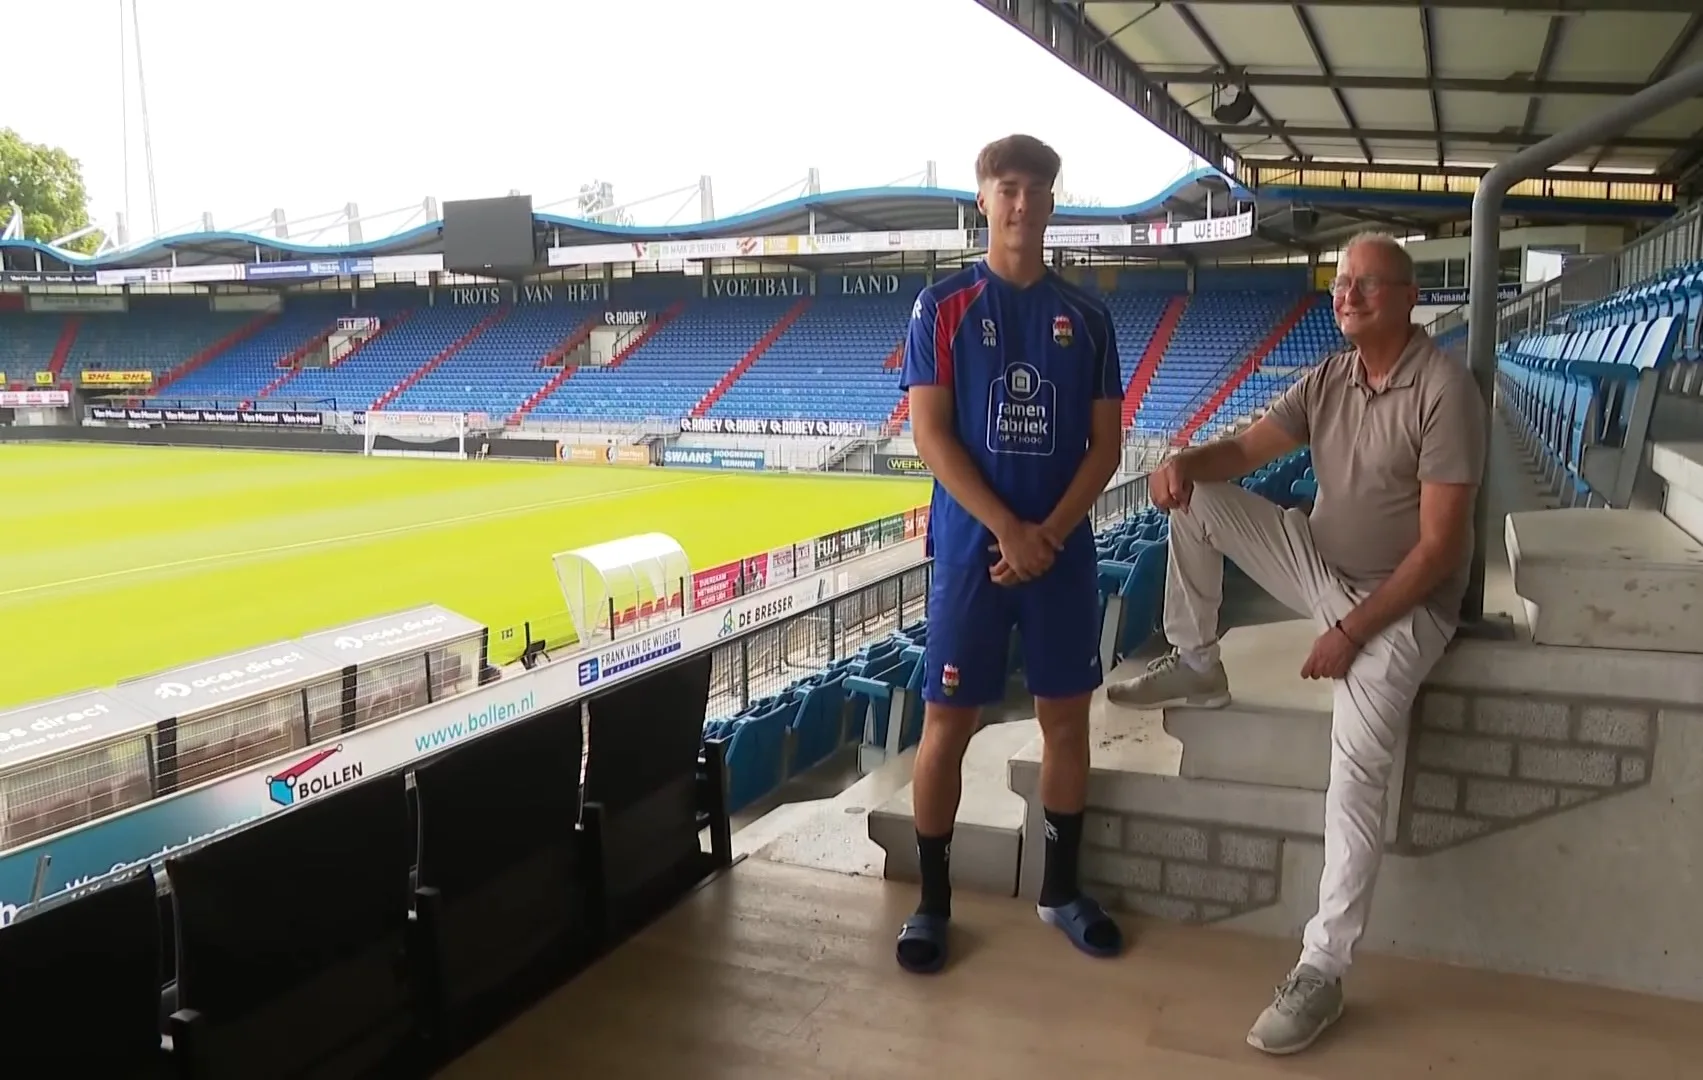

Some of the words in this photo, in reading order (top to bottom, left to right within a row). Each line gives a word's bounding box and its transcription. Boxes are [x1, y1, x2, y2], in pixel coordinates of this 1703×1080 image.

[1131, 222, 1182, 244] BTT
[1194, 223, 1212, 239] WE
[1214, 220, 1237, 237] LEAD
[452, 287, 500, 305] TROTS
[524, 284, 553, 303] VAN
[567, 283, 600, 302] HET
[712, 277, 803, 297] VOETBAL
[842, 274, 900, 295] LAND
[1431, 291, 1466, 303] Niemand
[616, 310, 647, 325] ROBEY
[998, 402, 1046, 418] ramen
[691, 418, 723, 432] ROBEY
[736, 419, 768, 434] ROBEY
[782, 420, 814, 435] ROBEY
[996, 415, 1048, 435] fabriek
[664, 450, 713, 464] SWAANS
[721, 459, 756, 468] VERHUUR
[739, 610, 751, 628] DE
[755, 595, 793, 620] BRESSER
[601, 648, 625, 668] FRANK
[626, 644, 640, 658] VAN
[642, 638, 651, 653] DE
[191, 669, 245, 688] aces
[245, 651, 304, 673] direct
[30, 703, 109, 731] direct
[415, 690, 534, 752] www.bollen.nl
[299, 761, 363, 799] BOLLEN
